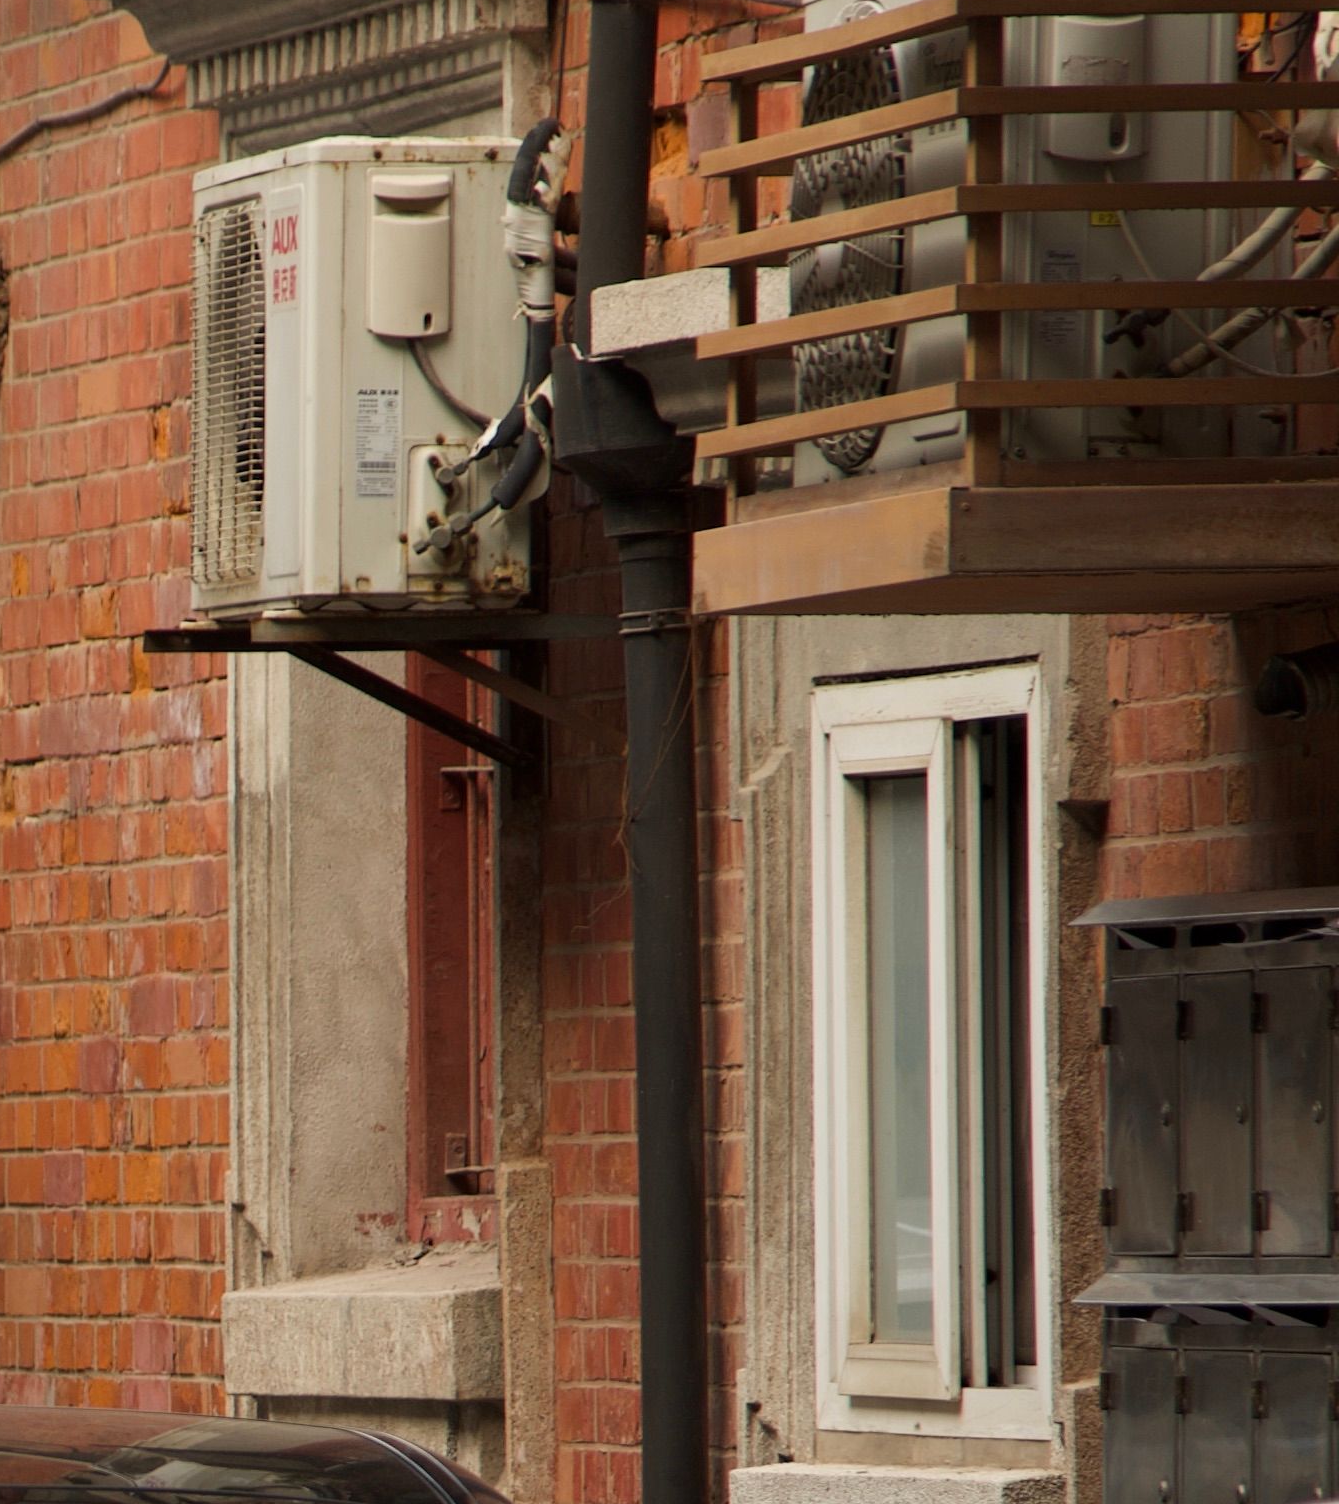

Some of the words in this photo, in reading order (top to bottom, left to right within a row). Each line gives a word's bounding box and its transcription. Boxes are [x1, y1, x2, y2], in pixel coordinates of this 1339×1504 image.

[271, 215, 298, 256] AUX
[273, 265, 297, 304] 奥克斯
